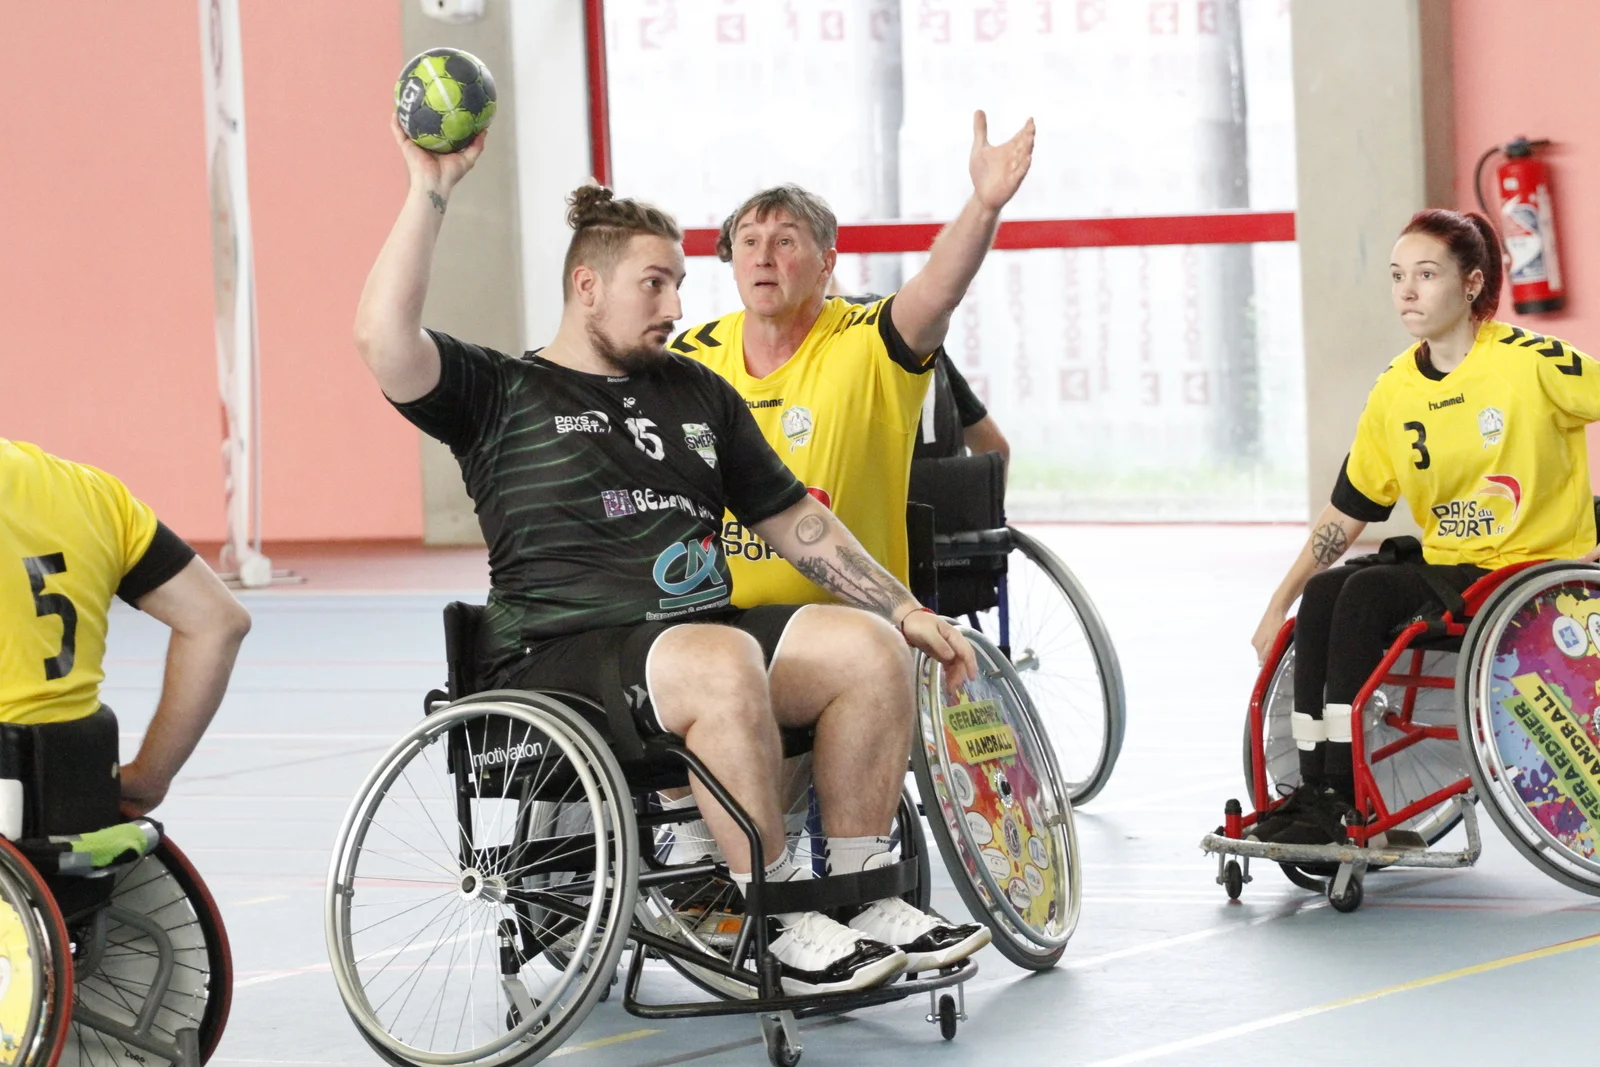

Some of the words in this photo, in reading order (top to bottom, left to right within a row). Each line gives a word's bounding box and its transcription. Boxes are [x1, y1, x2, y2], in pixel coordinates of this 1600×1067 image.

[399, 79, 421, 135] ELECT
[554, 415, 589, 425] PAYS
[1428, 393, 1465, 411] hummel
[624, 417, 666, 462] 15
[1403, 420, 1431, 470] 3
[1431, 500, 1477, 520] PAYS
[1478, 508, 1493, 518] du
[22, 551, 78, 681] 5
[965, 733, 1012, 758] HANDBALL
[1533, 685, 1600, 786] ANDBALL
